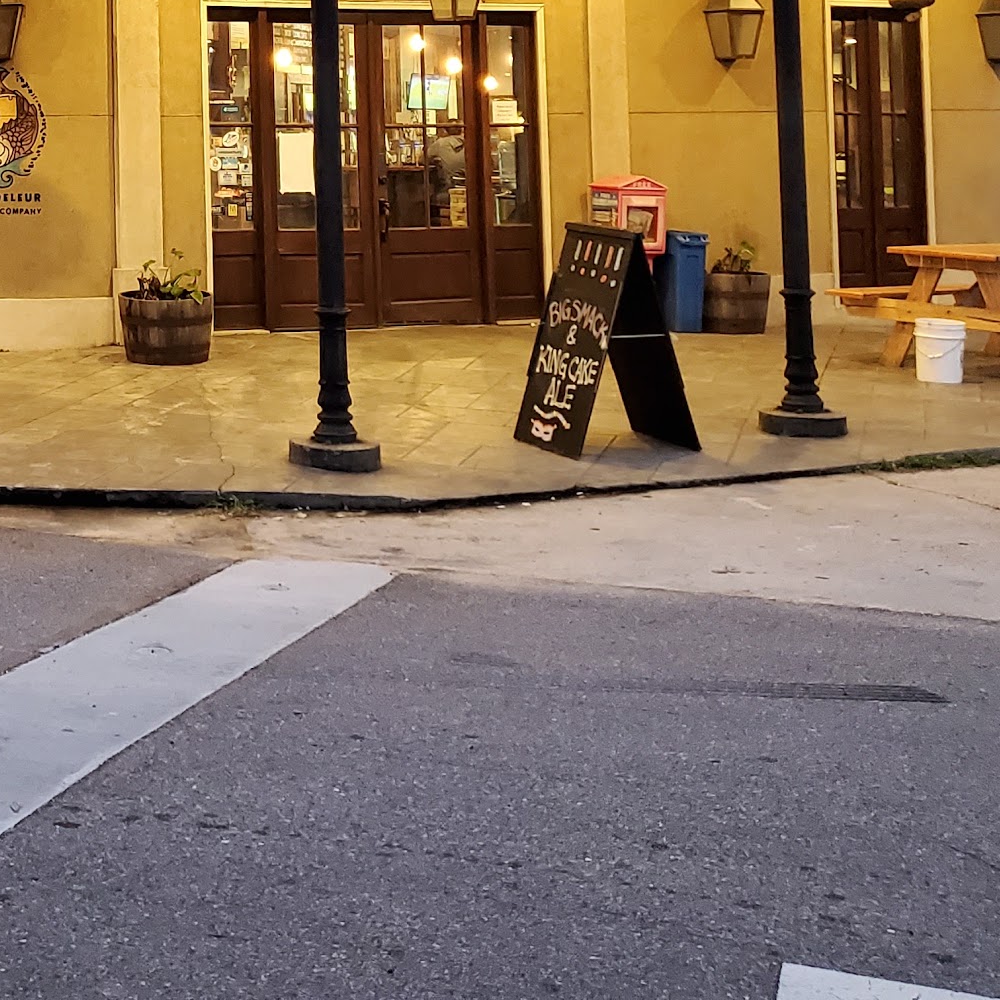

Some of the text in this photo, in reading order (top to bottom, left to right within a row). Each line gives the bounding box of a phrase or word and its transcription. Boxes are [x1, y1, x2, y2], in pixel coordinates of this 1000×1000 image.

[0, 207, 42, 215] COMPANY
[548, 298, 571, 328] BIG
[566, 323, 578, 346] &
[535, 344, 600, 386] KING CAKE
[543, 376, 577, 411] ALE
